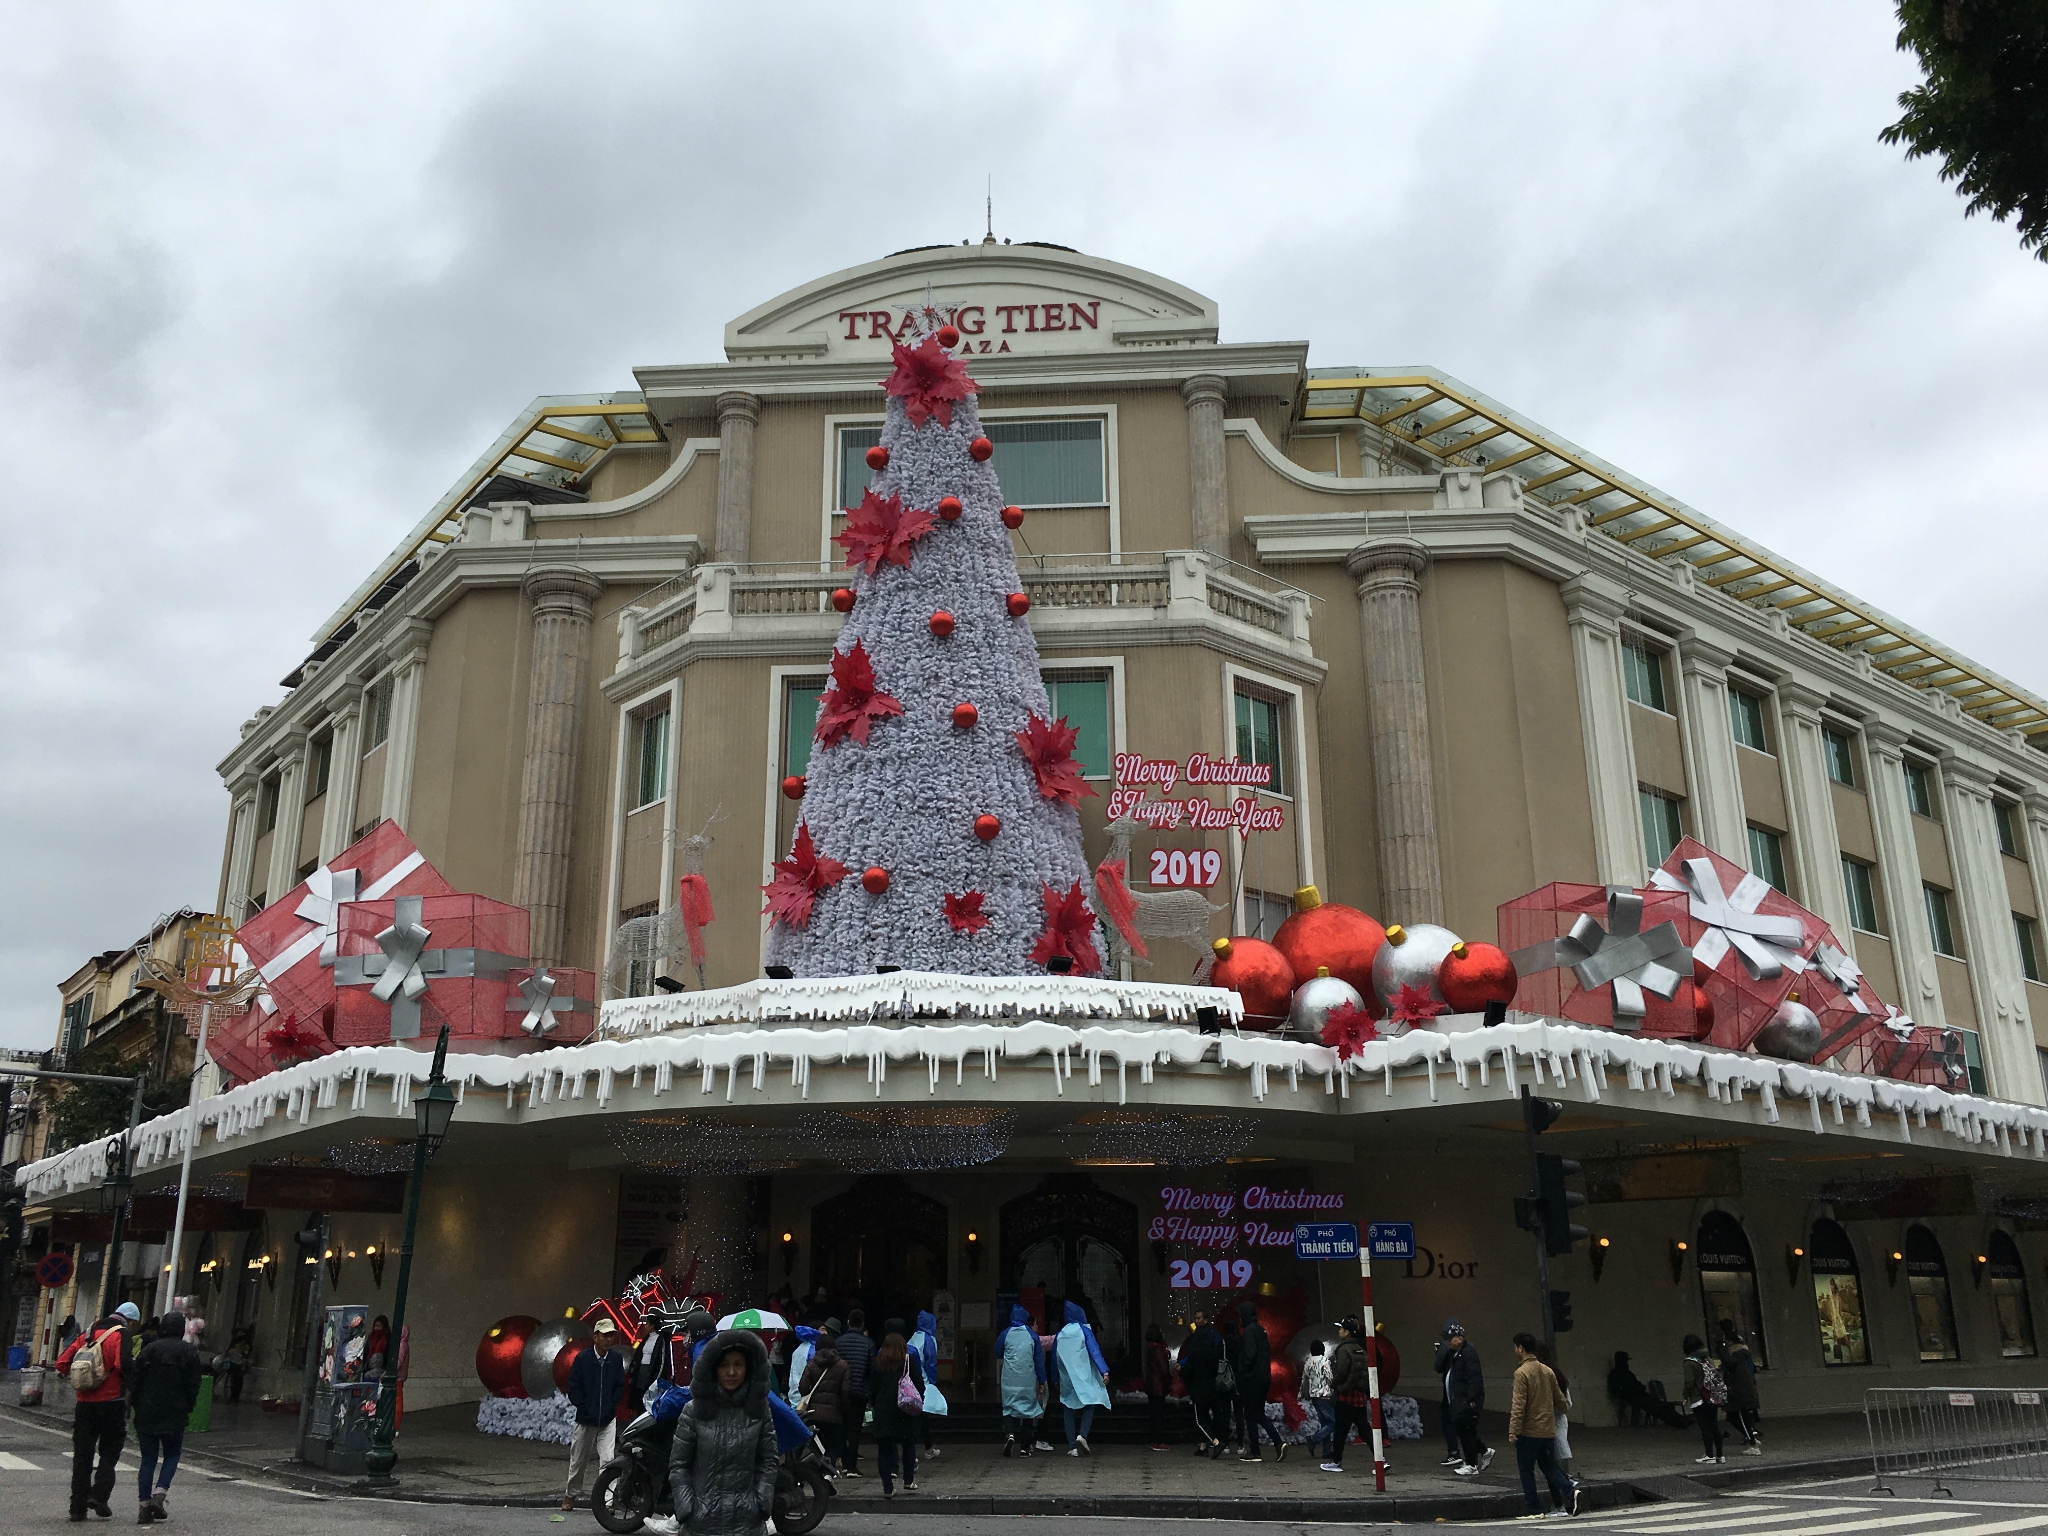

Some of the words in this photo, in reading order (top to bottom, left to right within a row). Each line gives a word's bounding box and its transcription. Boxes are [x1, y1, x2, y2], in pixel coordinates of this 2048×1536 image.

[996, 301, 1101, 333] TIEN
[960, 340, 1012, 355] AZA
[1114, 754, 1179, 792] Merry
[1185, 753, 1271, 784] Christmas
[1187, 798, 1234, 828] New
[1233, 798, 1283, 837] Year
[1150, 850, 1221, 885] 2019
[1160, 1186, 1236, 1219] Merry
[1242, 1185, 1345, 1210] Christmas
[1243, 1221, 1296, 1247] New
[1317, 1228, 1334, 1237] PHỐ
[1384, 1228, 1397, 1237] PHỐ
[1300, 1239, 1331, 1254] TRÀNG
[1375, 1239, 1395, 1253] HÀNG
[1395, 1239, 1408, 1253] BÀI
[1700, 1253, 1719, 1264] LOUIS
[1719, 1254, 1747, 1265] VUITTON
[1169, 1259, 1254, 1288] 2019
[1402, 1245, 1479, 1279] Dior
[1828, 1258, 1851, 1269] VUITTON
